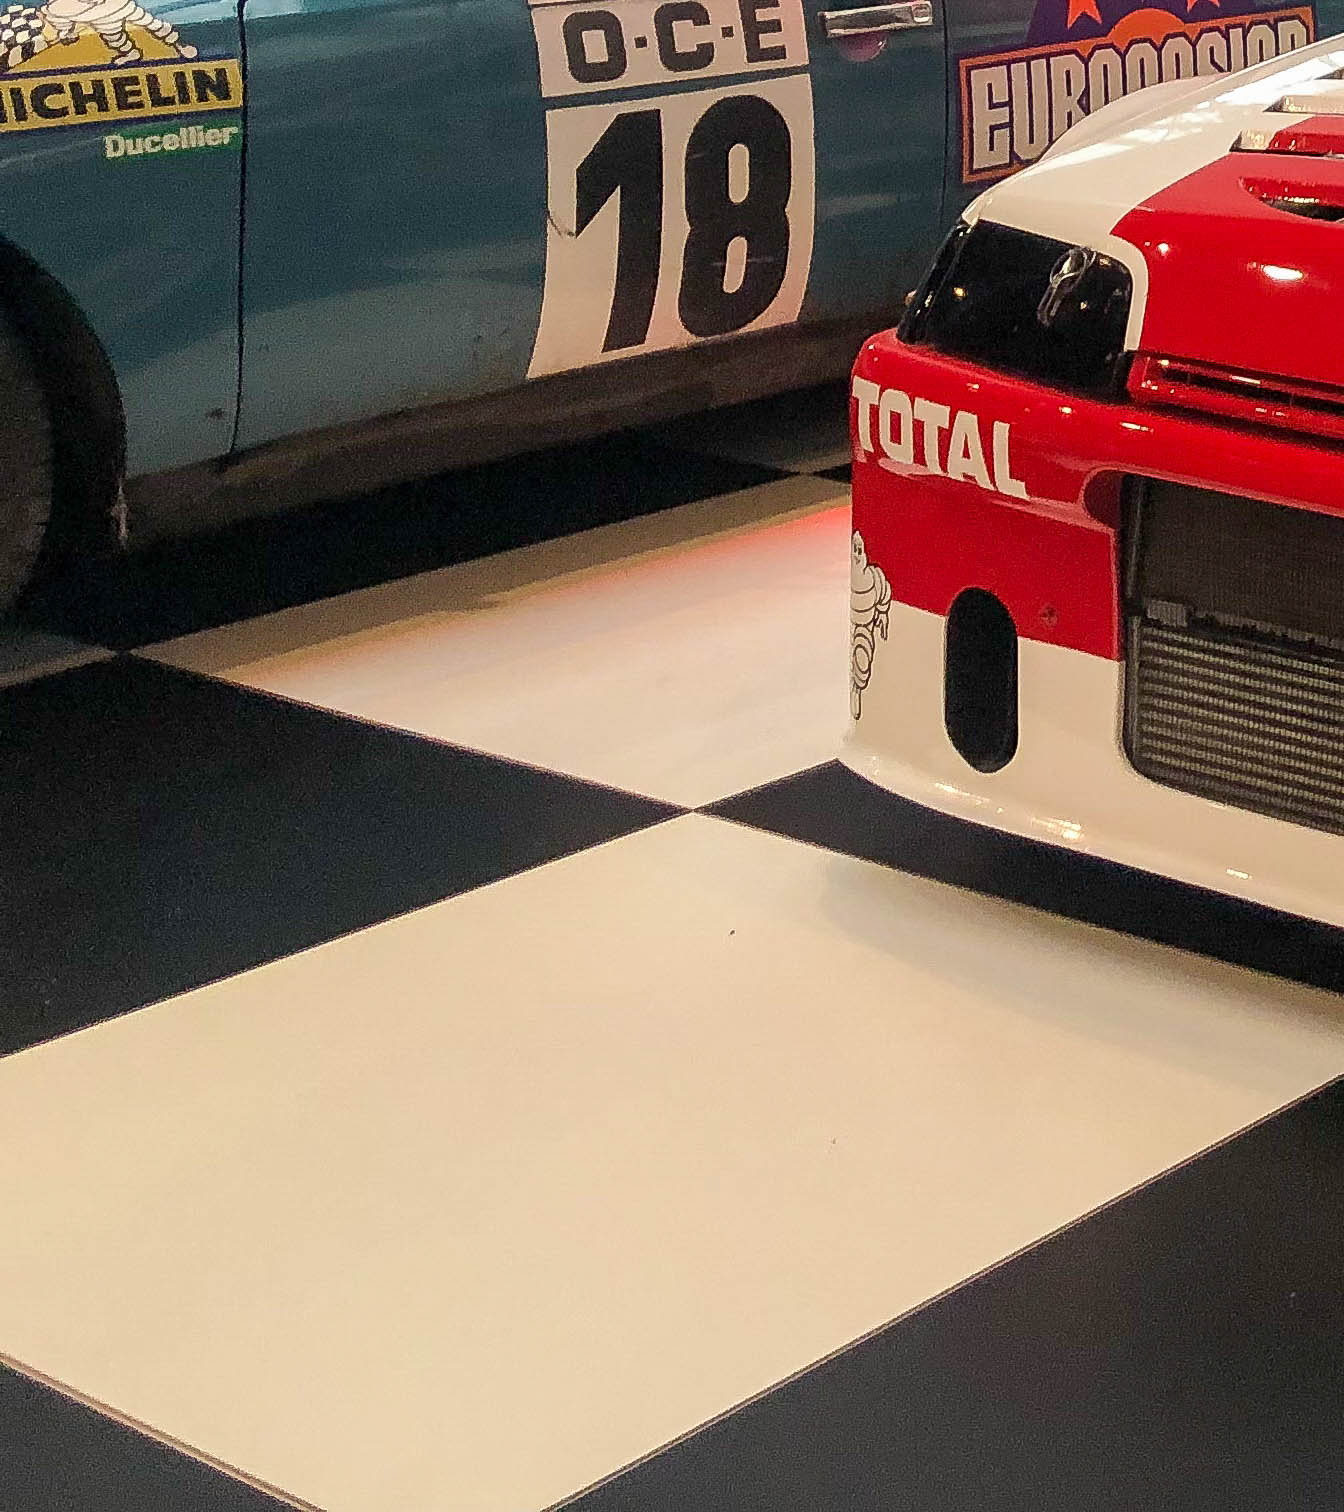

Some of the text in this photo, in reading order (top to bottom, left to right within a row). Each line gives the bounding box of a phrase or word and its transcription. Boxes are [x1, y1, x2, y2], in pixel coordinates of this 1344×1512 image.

[0, 67, 232, 124] ICHELIN
[103, 125, 239, 160] Ducellier
[575, 94, 792, 354] 18
[851, 376, 1030, 500] TOTAL
